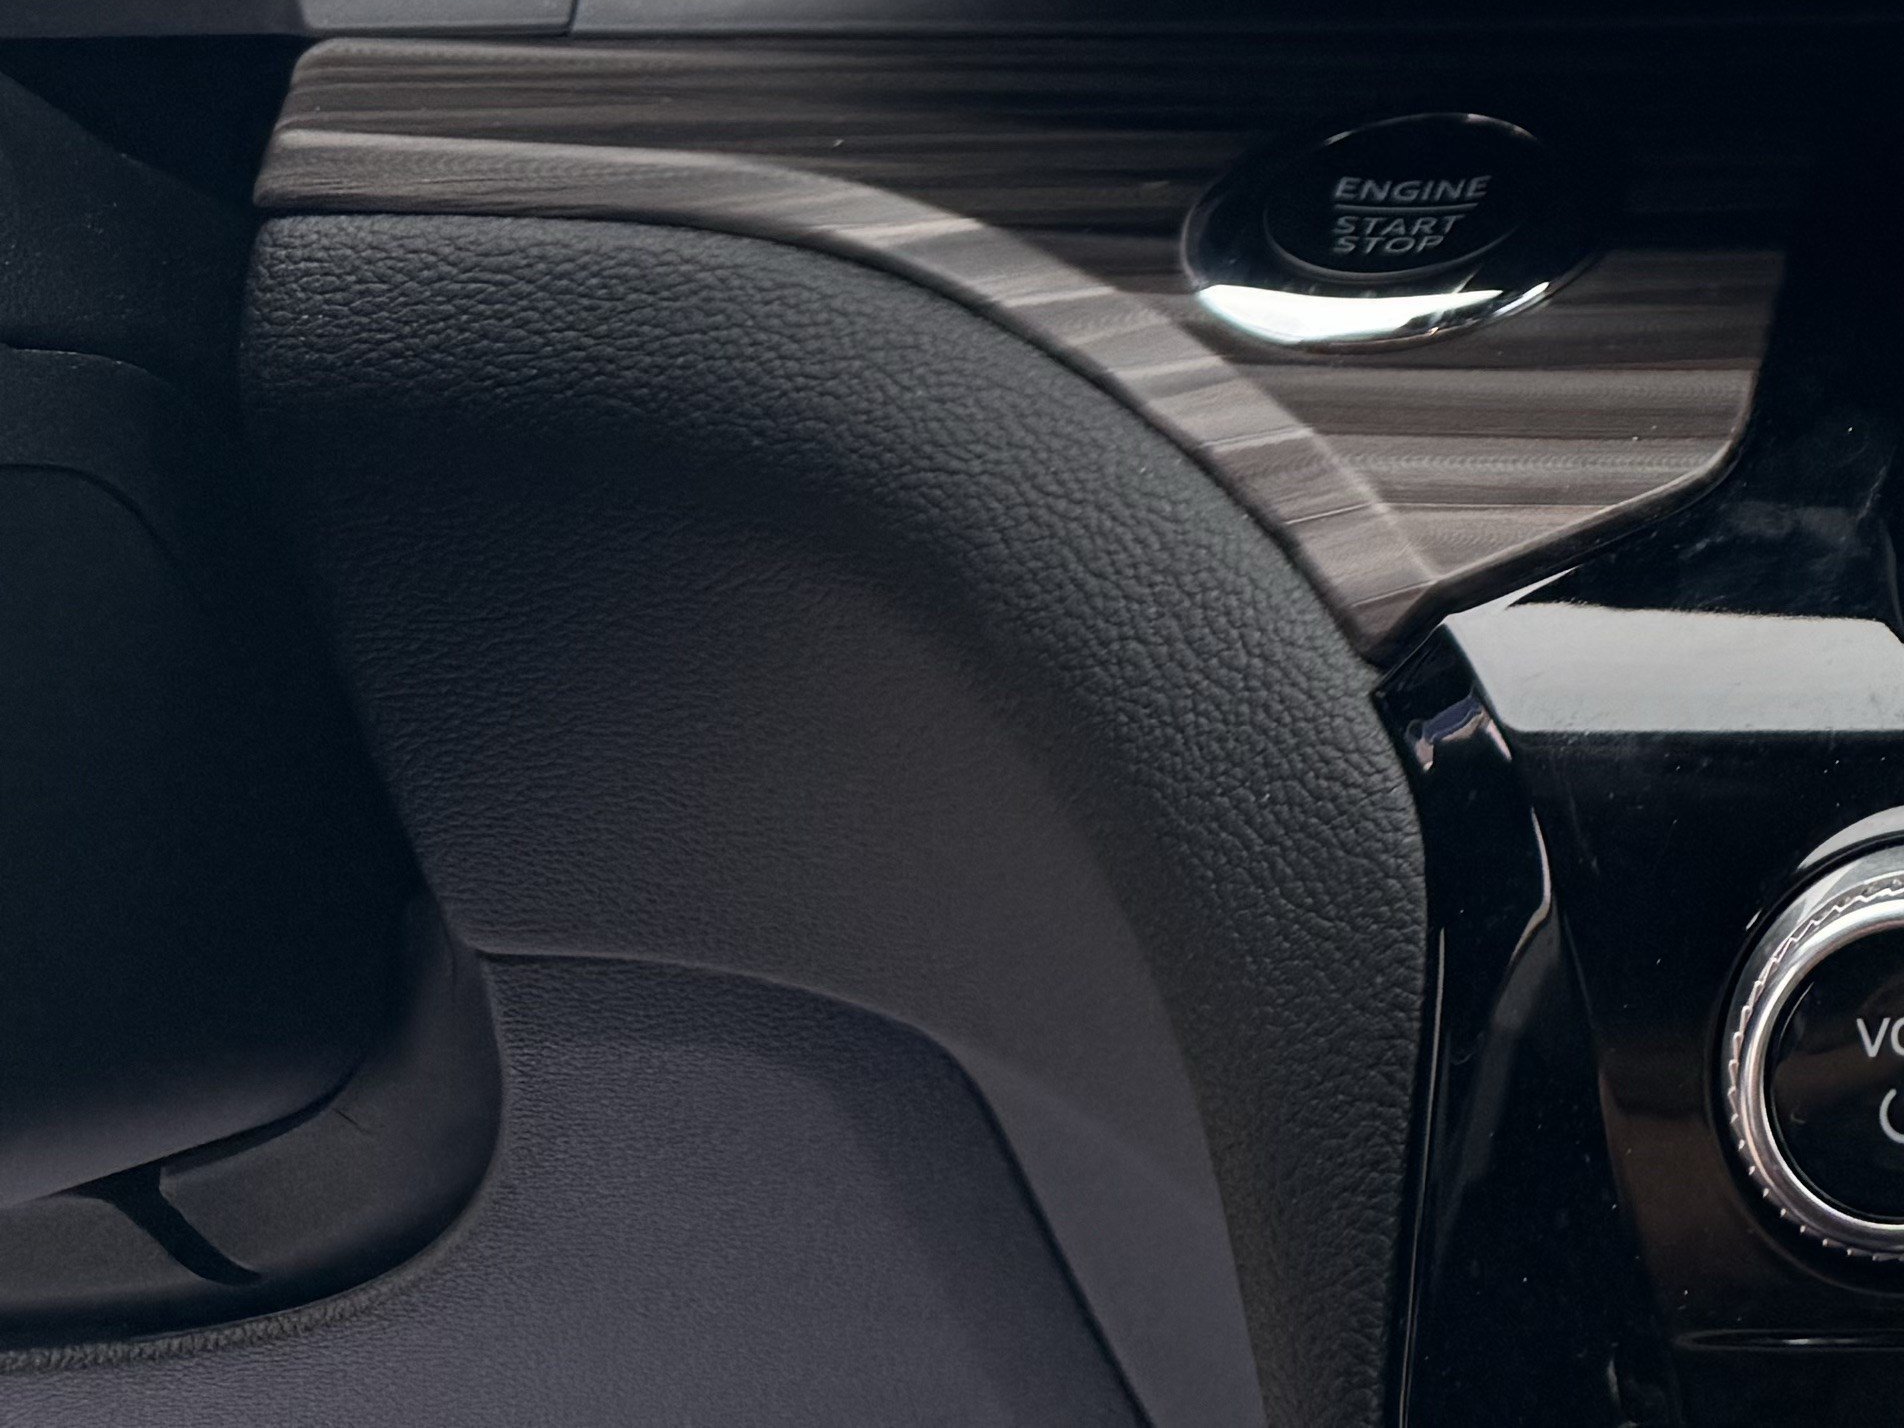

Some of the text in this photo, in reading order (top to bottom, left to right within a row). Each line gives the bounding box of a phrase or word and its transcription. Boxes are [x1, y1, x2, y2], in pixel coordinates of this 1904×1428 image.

[1333, 175, 1492, 202] ENGINE
[1333, 214, 1467, 236] START
[1333, 234, 1447, 255] STOP
